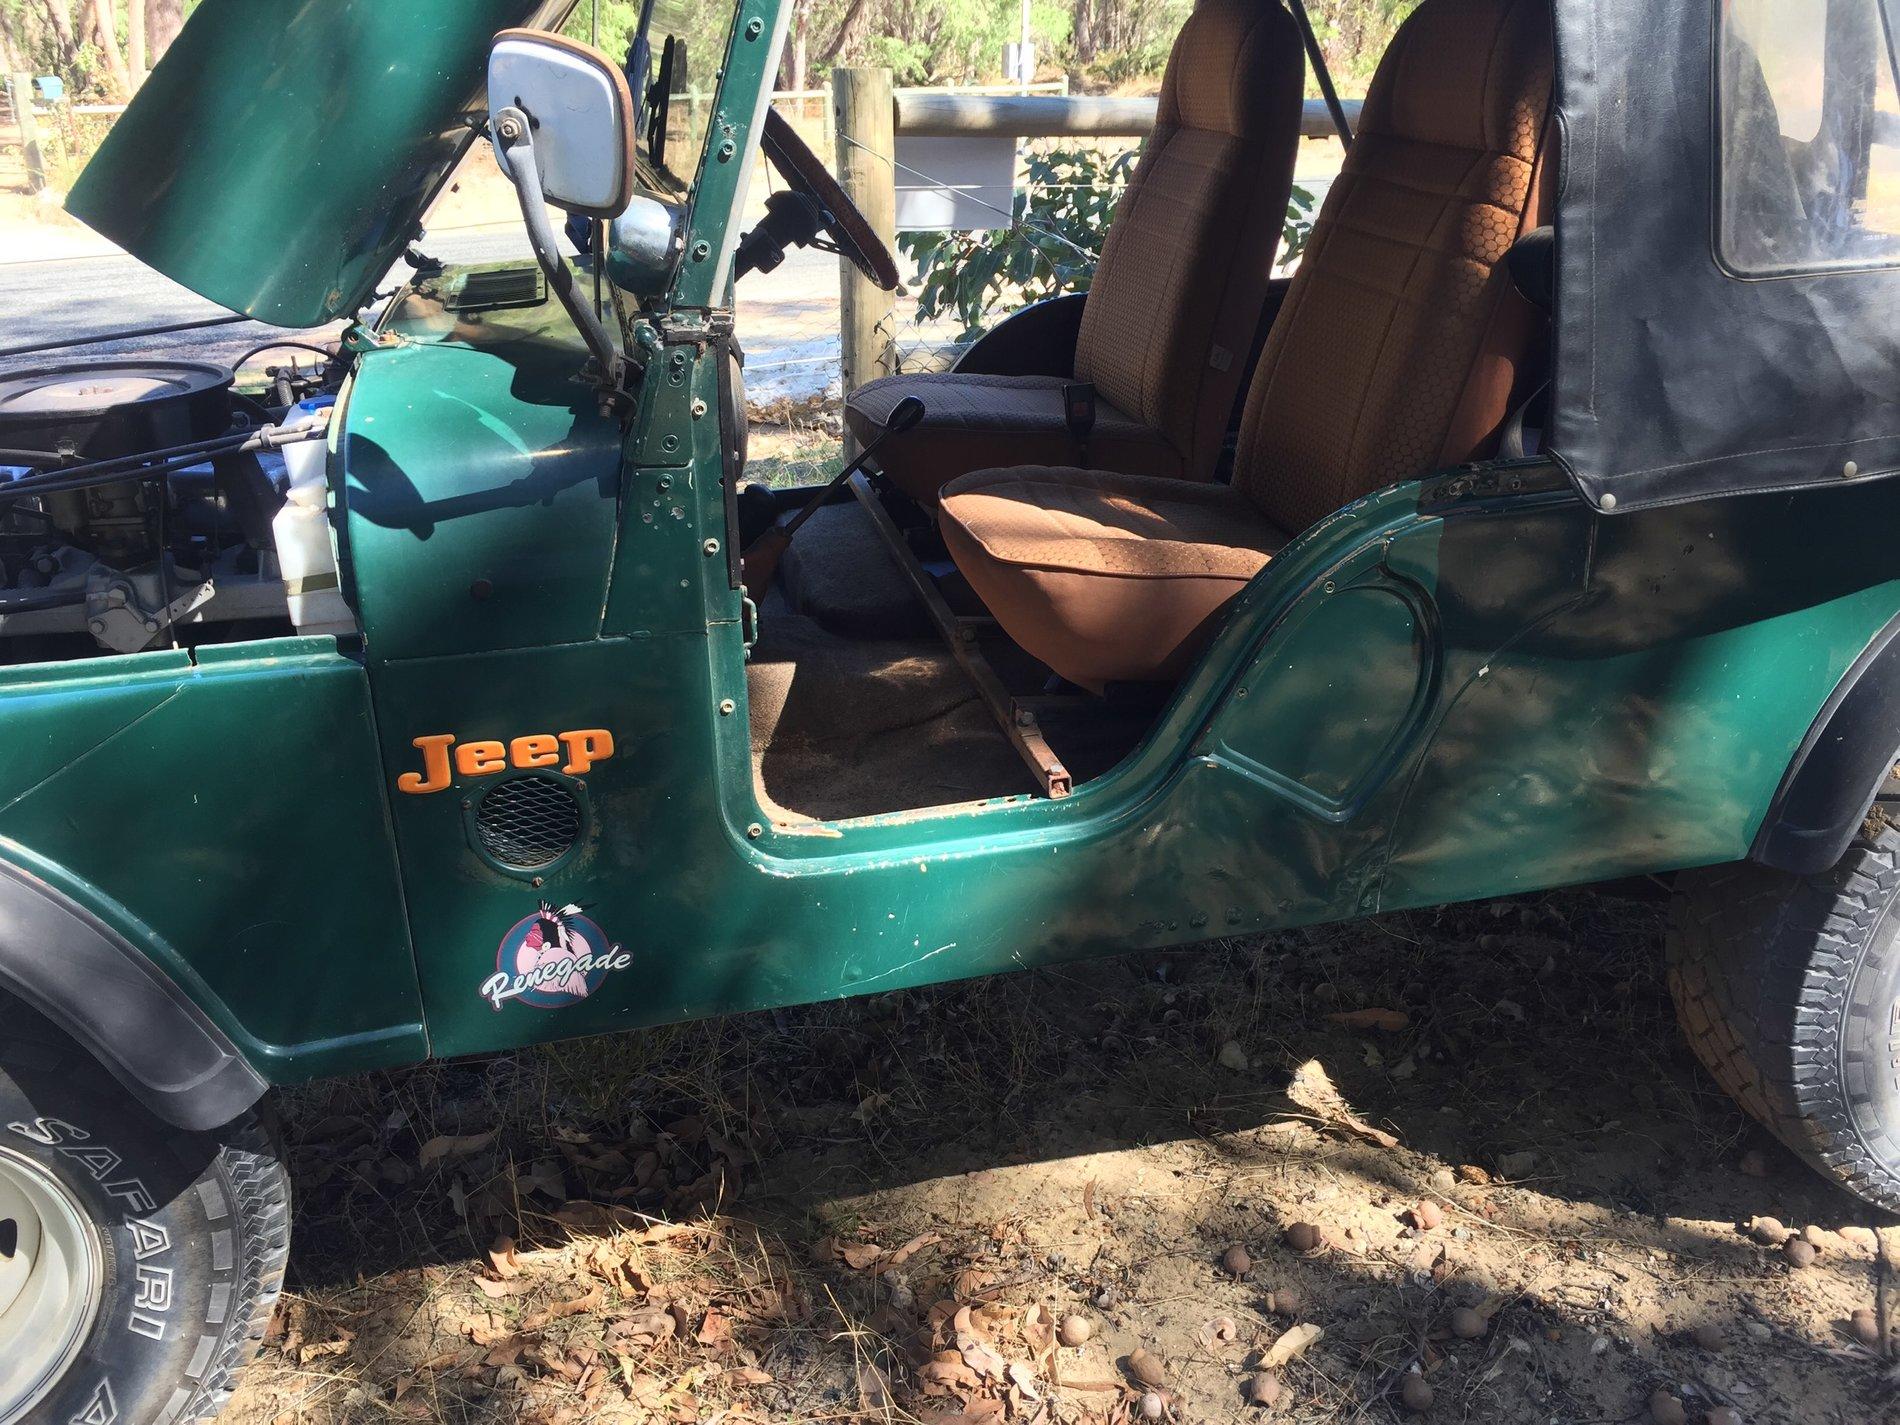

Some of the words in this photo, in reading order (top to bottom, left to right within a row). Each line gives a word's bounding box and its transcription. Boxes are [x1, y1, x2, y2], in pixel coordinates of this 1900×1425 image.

[398, 729, 615, 794] Jeep
[480, 945, 633, 1010] Renegade
[7, 1117, 171, 1341] SAFARI
